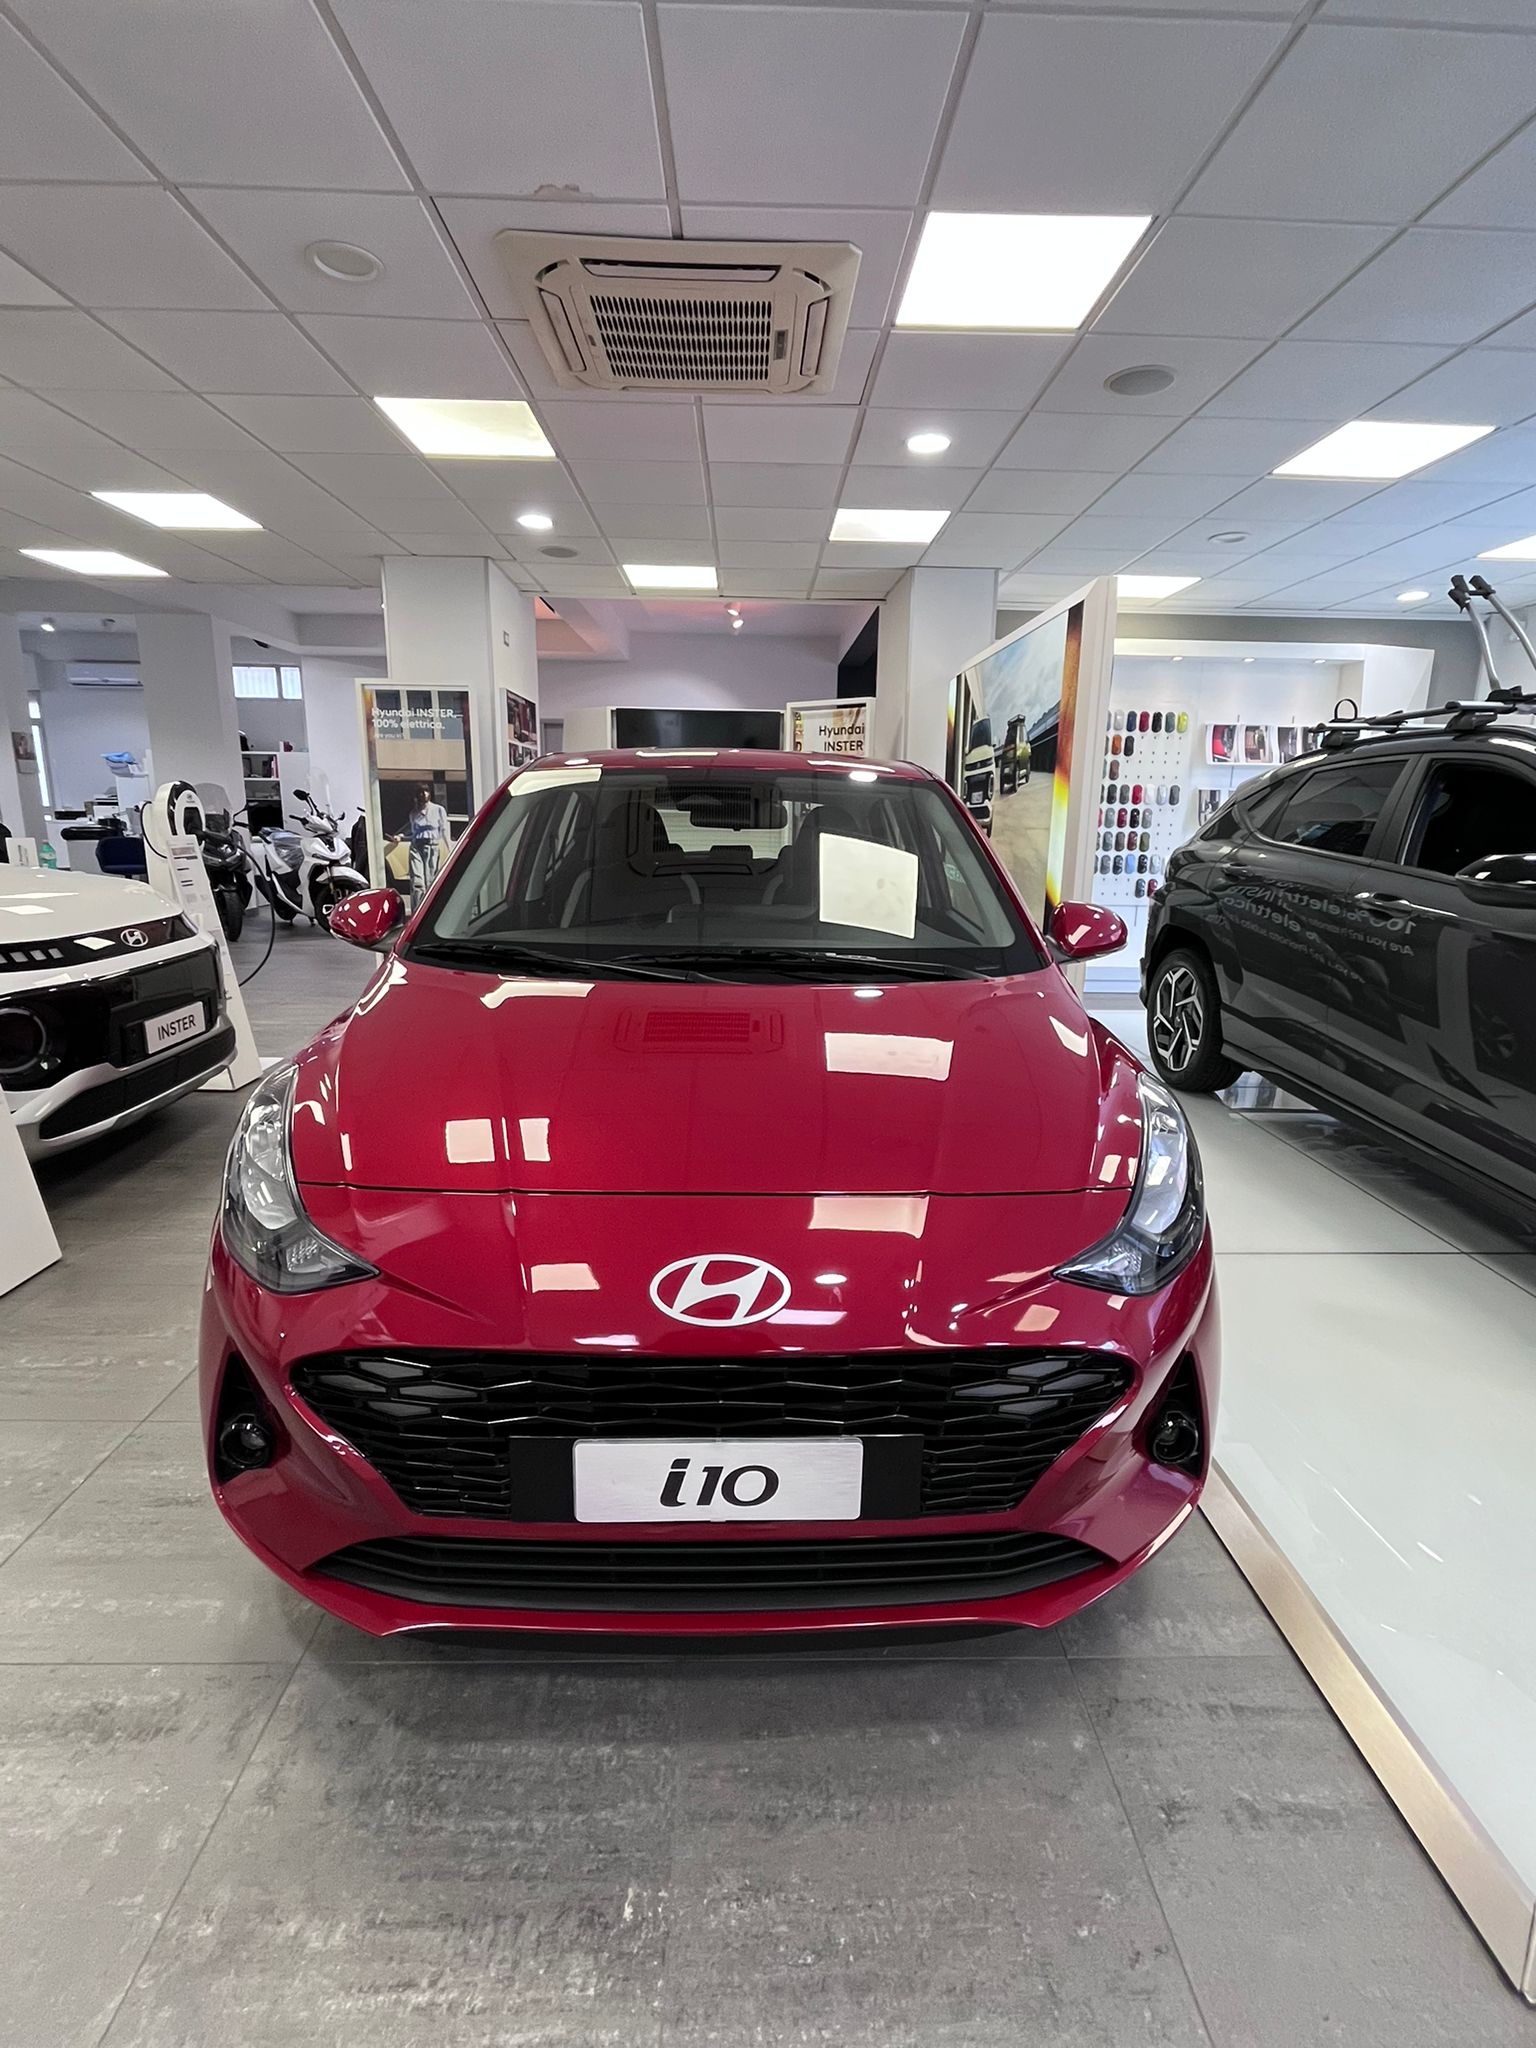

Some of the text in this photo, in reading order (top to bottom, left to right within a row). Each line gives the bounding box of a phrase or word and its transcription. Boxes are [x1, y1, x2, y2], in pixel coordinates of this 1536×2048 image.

[371, 707, 415, 719] Hyundai
[371, 719, 399, 729] 100%
[819, 723, 865, 738] Hyundai
[824, 741, 863, 751] INSTER
[157, 1014, 197, 1041] INSTER
[659, 1458, 779, 1508] i10
